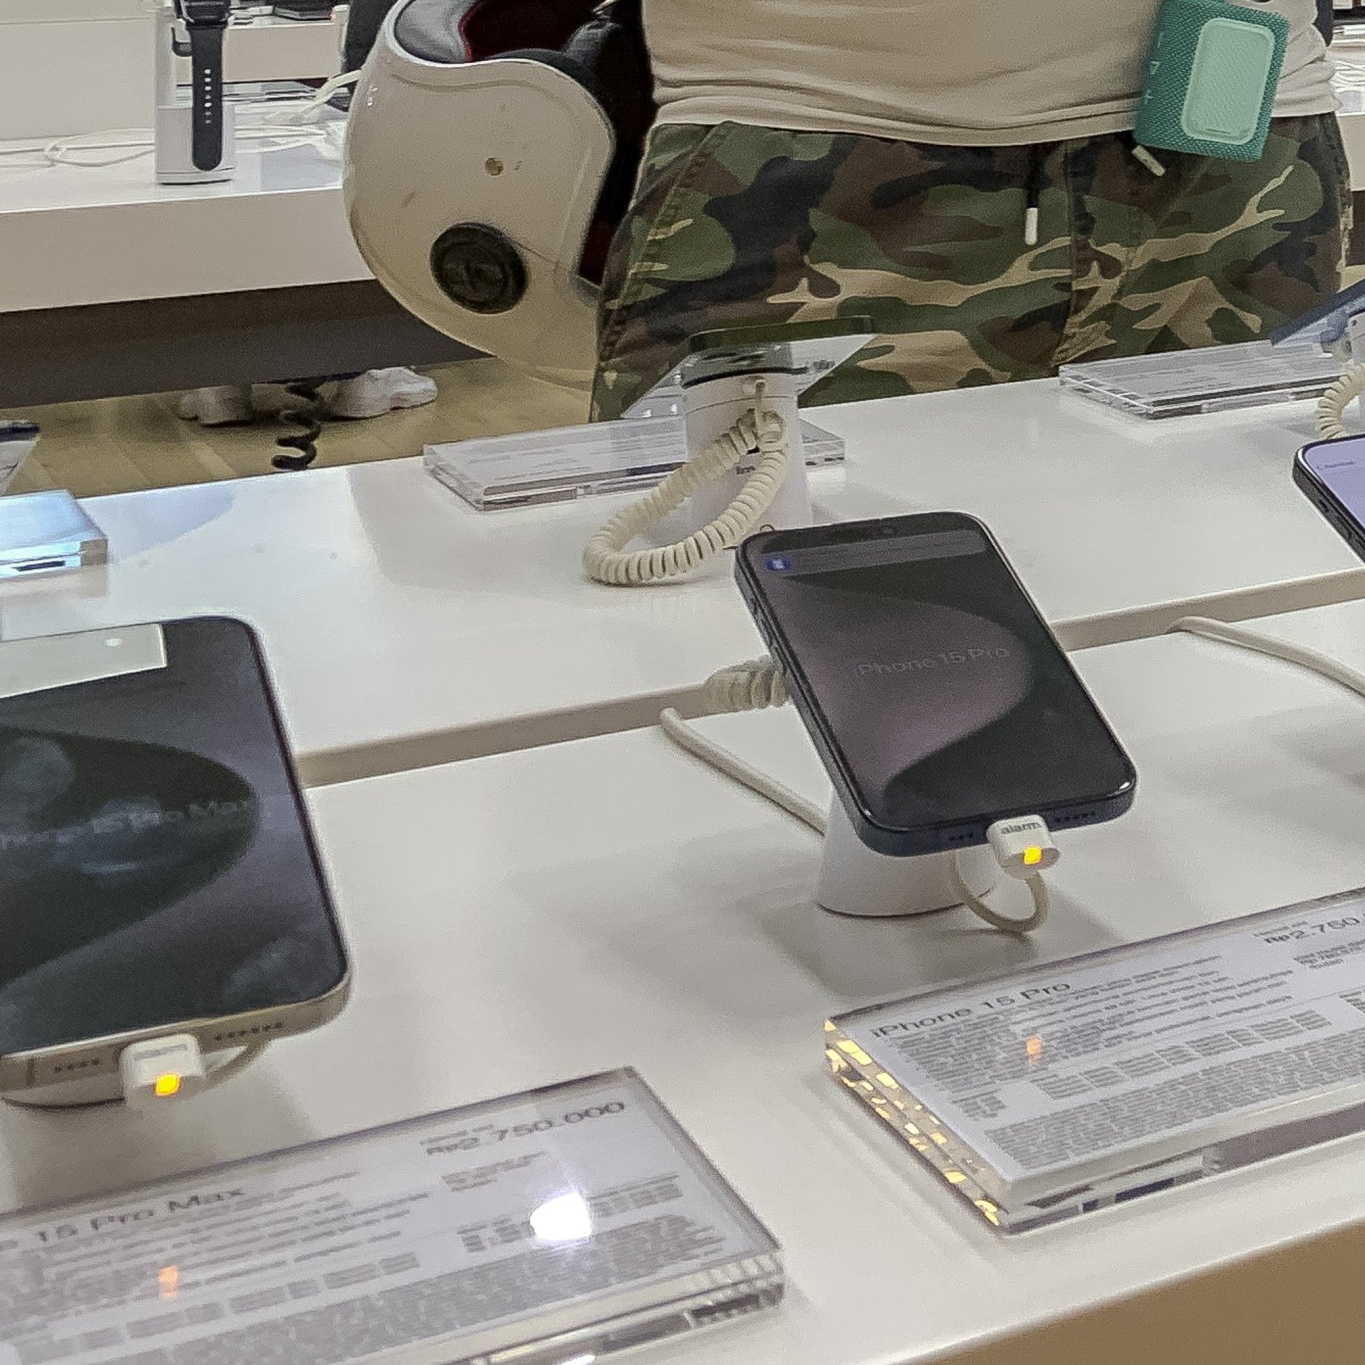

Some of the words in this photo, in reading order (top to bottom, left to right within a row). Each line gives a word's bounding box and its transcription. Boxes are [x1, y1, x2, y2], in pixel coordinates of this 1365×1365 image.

[1001, 822, 1041, 835] alarm
[870, 1008, 971, 1038] iPhone
[980, 995, 1015, 1009] 15
[1019, 983, 1071, 1000] Pro
